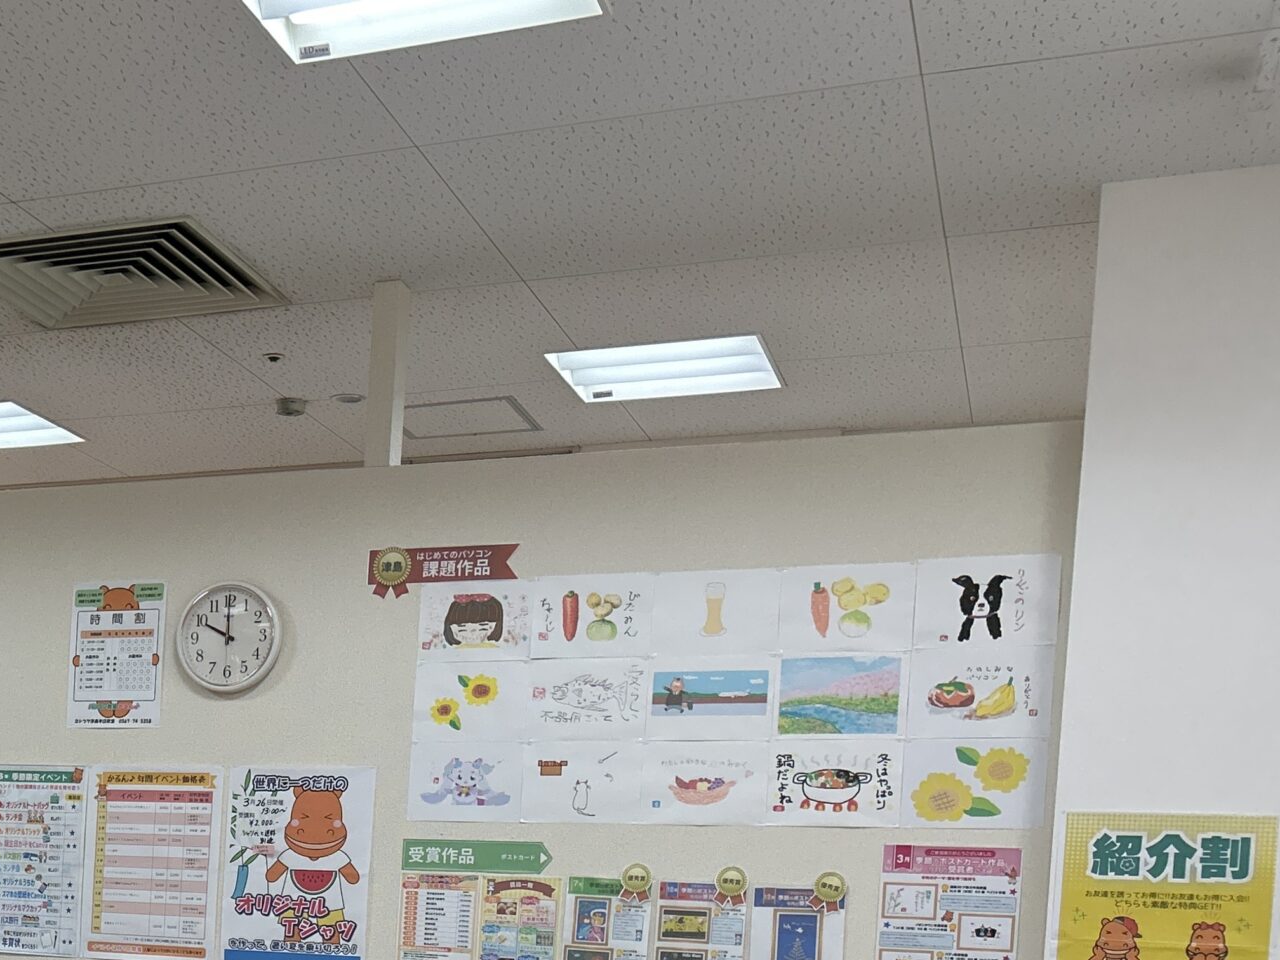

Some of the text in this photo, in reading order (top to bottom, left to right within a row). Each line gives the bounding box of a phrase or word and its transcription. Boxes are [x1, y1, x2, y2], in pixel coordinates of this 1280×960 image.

[416, 550, 492, 561] はじめてのパソコン
[381, 562, 403, 573] 津島
[422, 560, 491, 578] 課題作品
[210, 600, 219, 613] 11
[224, 594, 236, 608] 12
[244, 599, 248, 611] 1
[90, 612, 146, 625] 時間割
[196, 614, 208, 627] 10
[254, 611, 263, 623] 2
[623, 591, 640, 637] びたみん
[190, 632, 199, 645] 9
[259, 629, 267, 642] 3
[195, 650, 204, 662] 8
[252, 647, 260, 660] 4
[209, 662, 217, 674] 7
[223, 666, 231, 679] 6
[240, 661, 248, 674] 5
[254, 776, 347, 790] 世界に一つだけの
[776, 754, 795, 804] 鍋だよね
[408, 847, 475, 865] 受賞作品
[897, 854, 910, 863] 3月
[1090, 832, 1252, 880] 紹介割
[235, 894, 329, 917] オリジナル
[282, 918, 356, 941] Tシャツ
[2, 938, 20, 948] 年賀状
